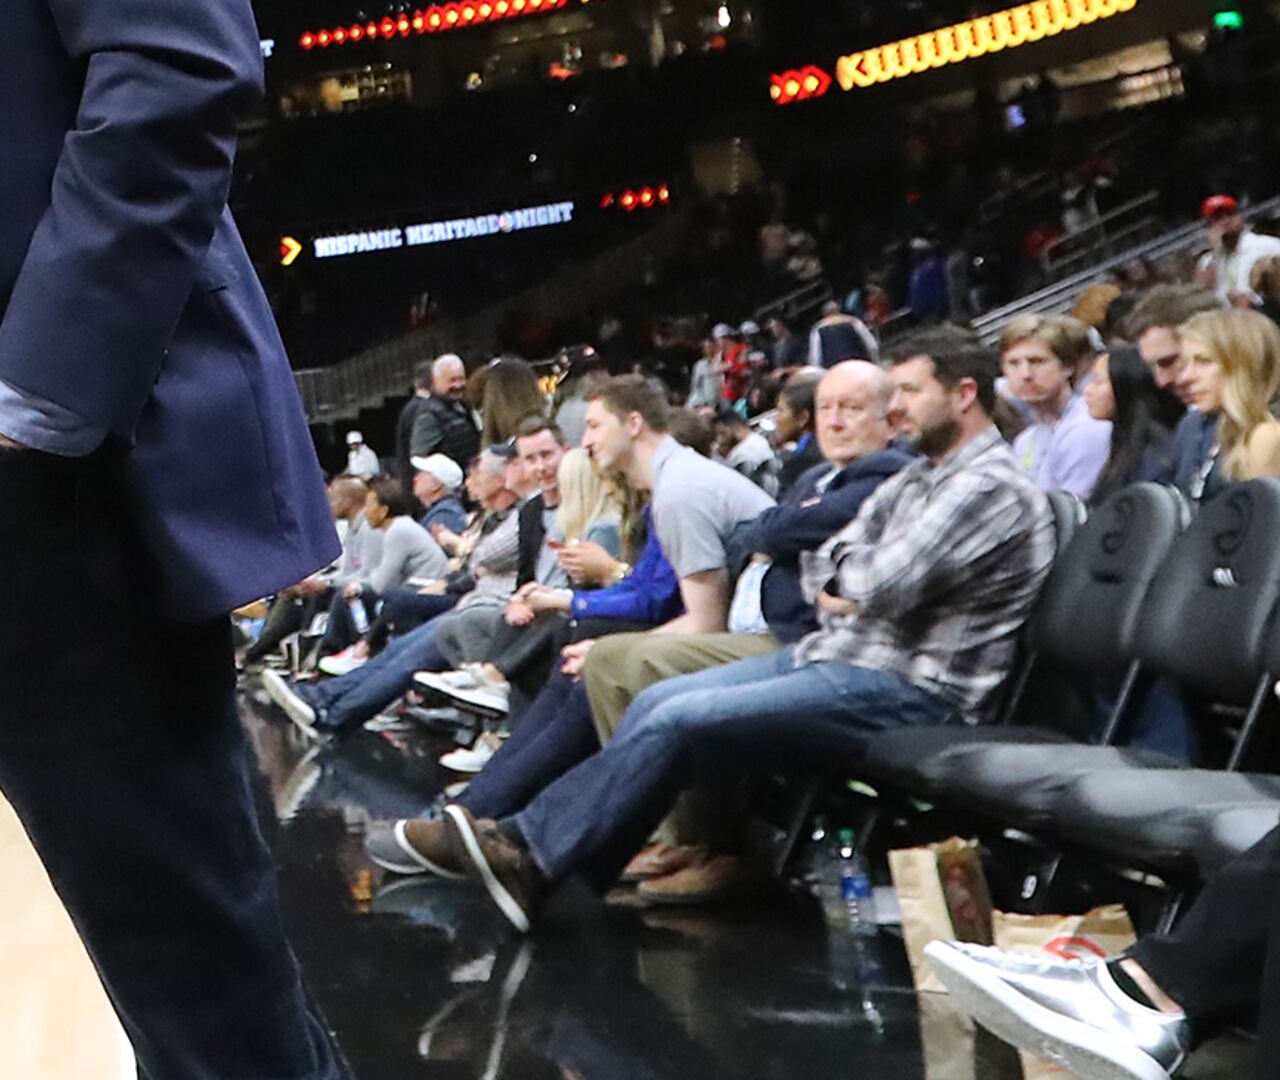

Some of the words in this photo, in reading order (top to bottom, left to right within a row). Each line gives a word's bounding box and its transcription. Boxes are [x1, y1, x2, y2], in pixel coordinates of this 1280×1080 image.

[314, 228, 402, 258] HISPANIC
[405, 214, 500, 246] HERITAGE
[513, 201, 574, 230] NIGHT
